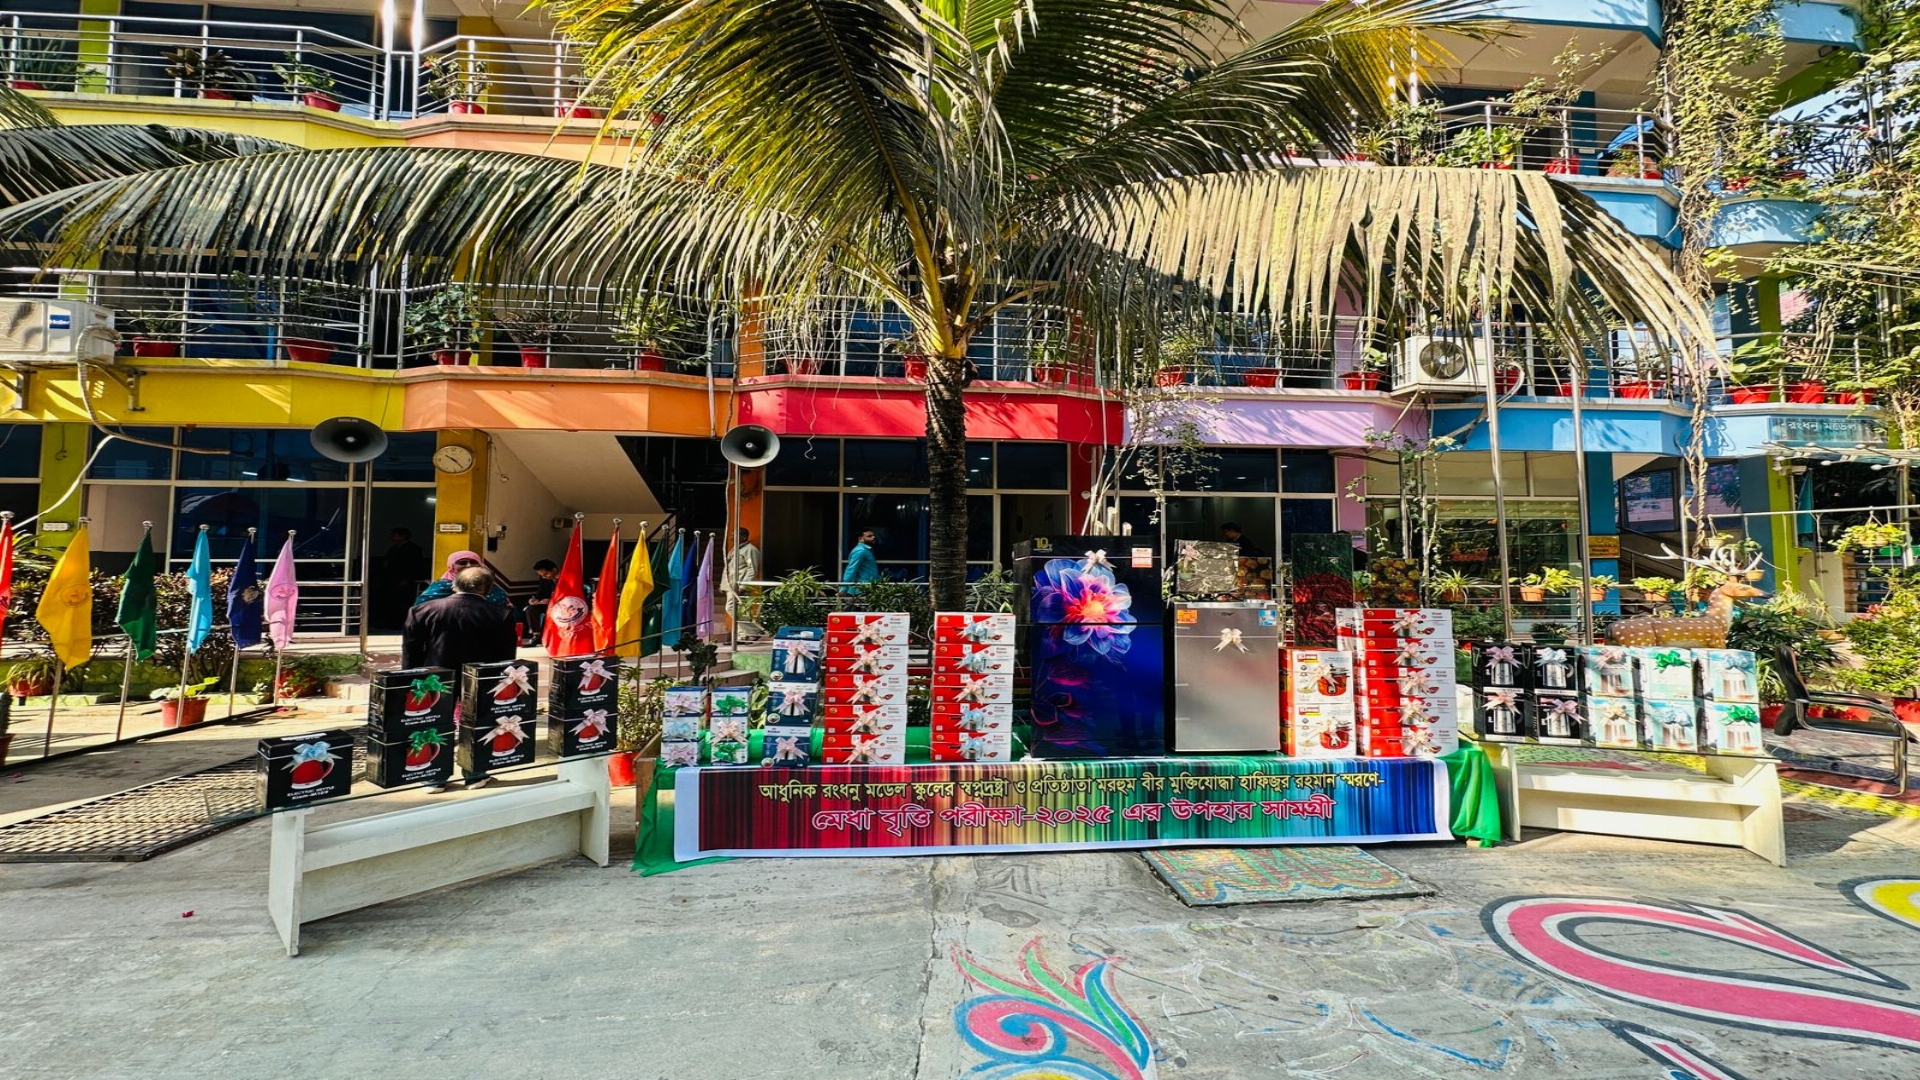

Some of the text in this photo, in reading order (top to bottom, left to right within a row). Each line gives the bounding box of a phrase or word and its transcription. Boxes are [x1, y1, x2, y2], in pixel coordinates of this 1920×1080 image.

[758, 779, 818, 803] আধুনিক
[821, 783, 862, 802] রংধনু
[864, 782, 908, 798] মডেল
[911, 781, 956, 801] স্কুলের
[1013, 780, 1026, 794] ও
[1030, 773, 1093, 795] প্রতিষ্ঠাতা
[1095, 777, 1137, 795] মরহুম
[1140, 771, 1165, 792] বীর
[1168, 771, 1235, 794] মুক্তিযোদ্ধা
[1238, 770, 1291, 792] হাফিজুর
[1294, 773, 1337, 790] রহমান
[812, 807, 876, 831] মেধা
[878, 802, 934, 837] বৃত্তি
[1122, 803, 1165, 822] এর
[1167, 797, 1257, 823] উপহার
[1259, 793, 1337, 820] সামগ্রী
